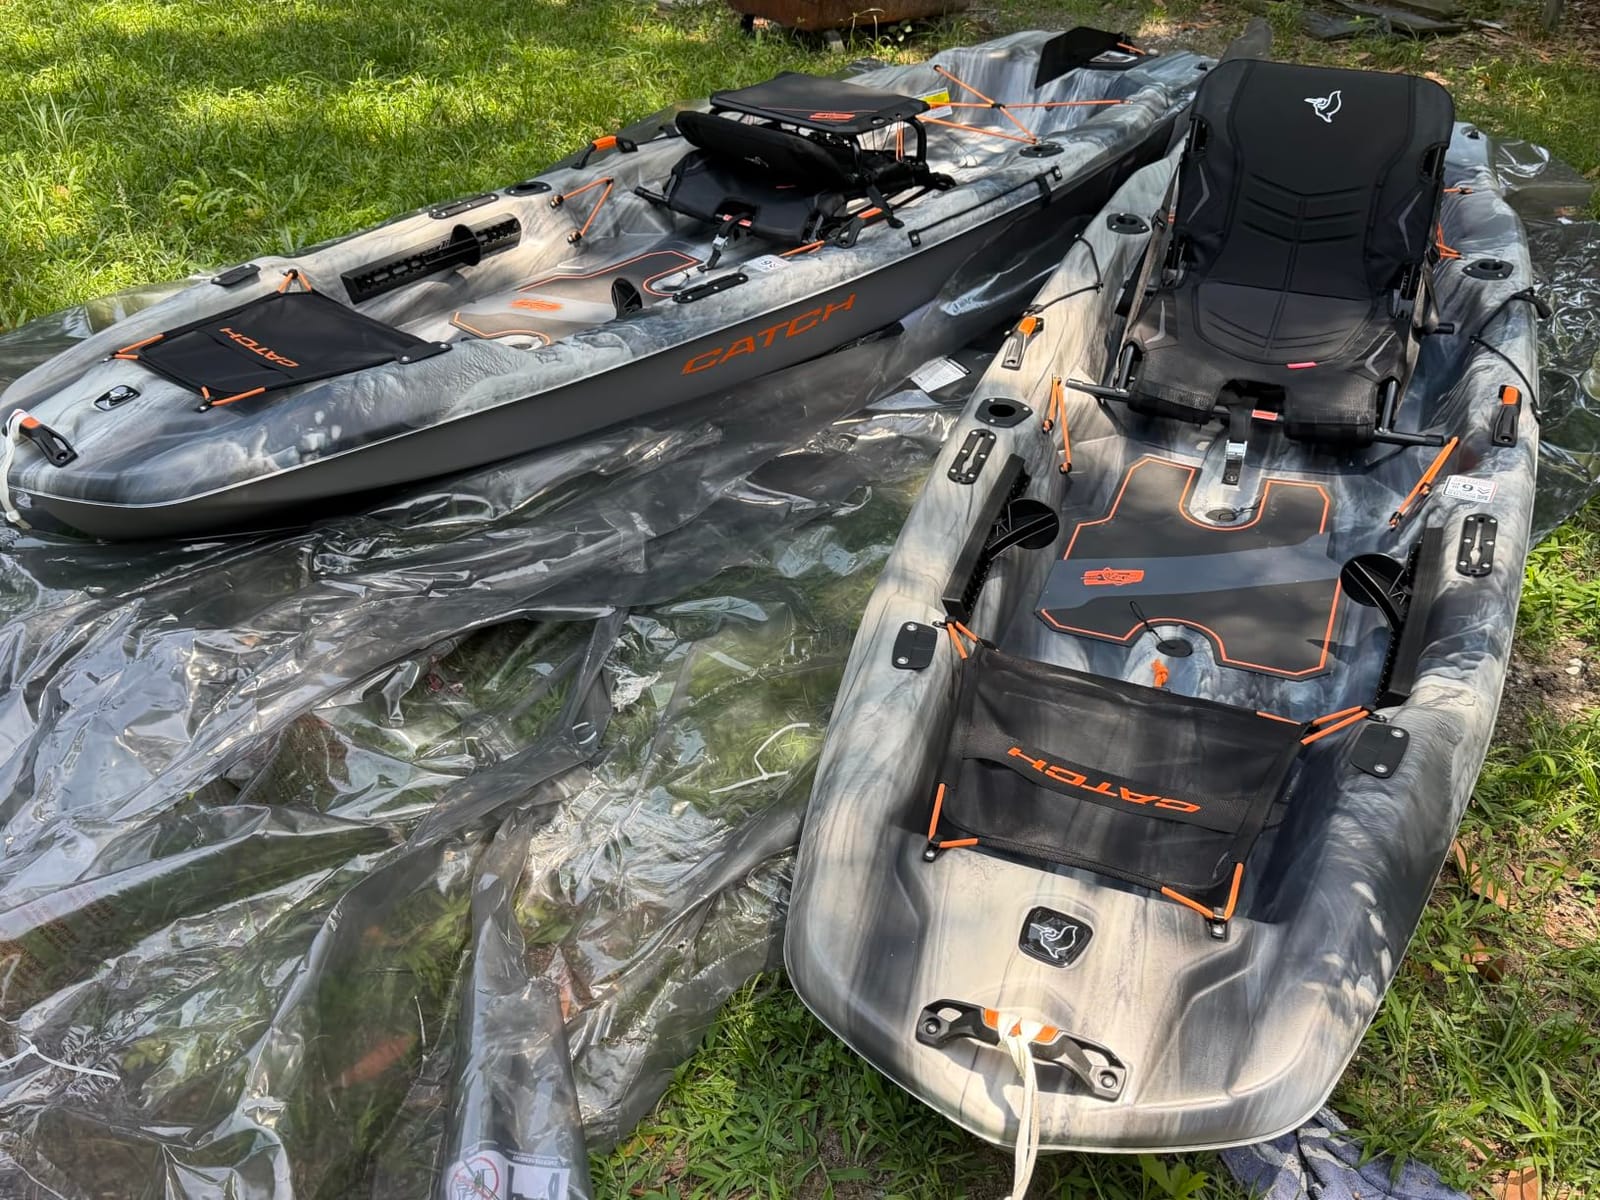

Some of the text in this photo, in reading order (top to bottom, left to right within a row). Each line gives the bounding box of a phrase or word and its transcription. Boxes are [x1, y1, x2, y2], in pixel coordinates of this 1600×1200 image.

[219, 327, 300, 368] CATCH
[680, 292, 857, 376] CATCH
[1007, 747, 1201, 814] CATCH
